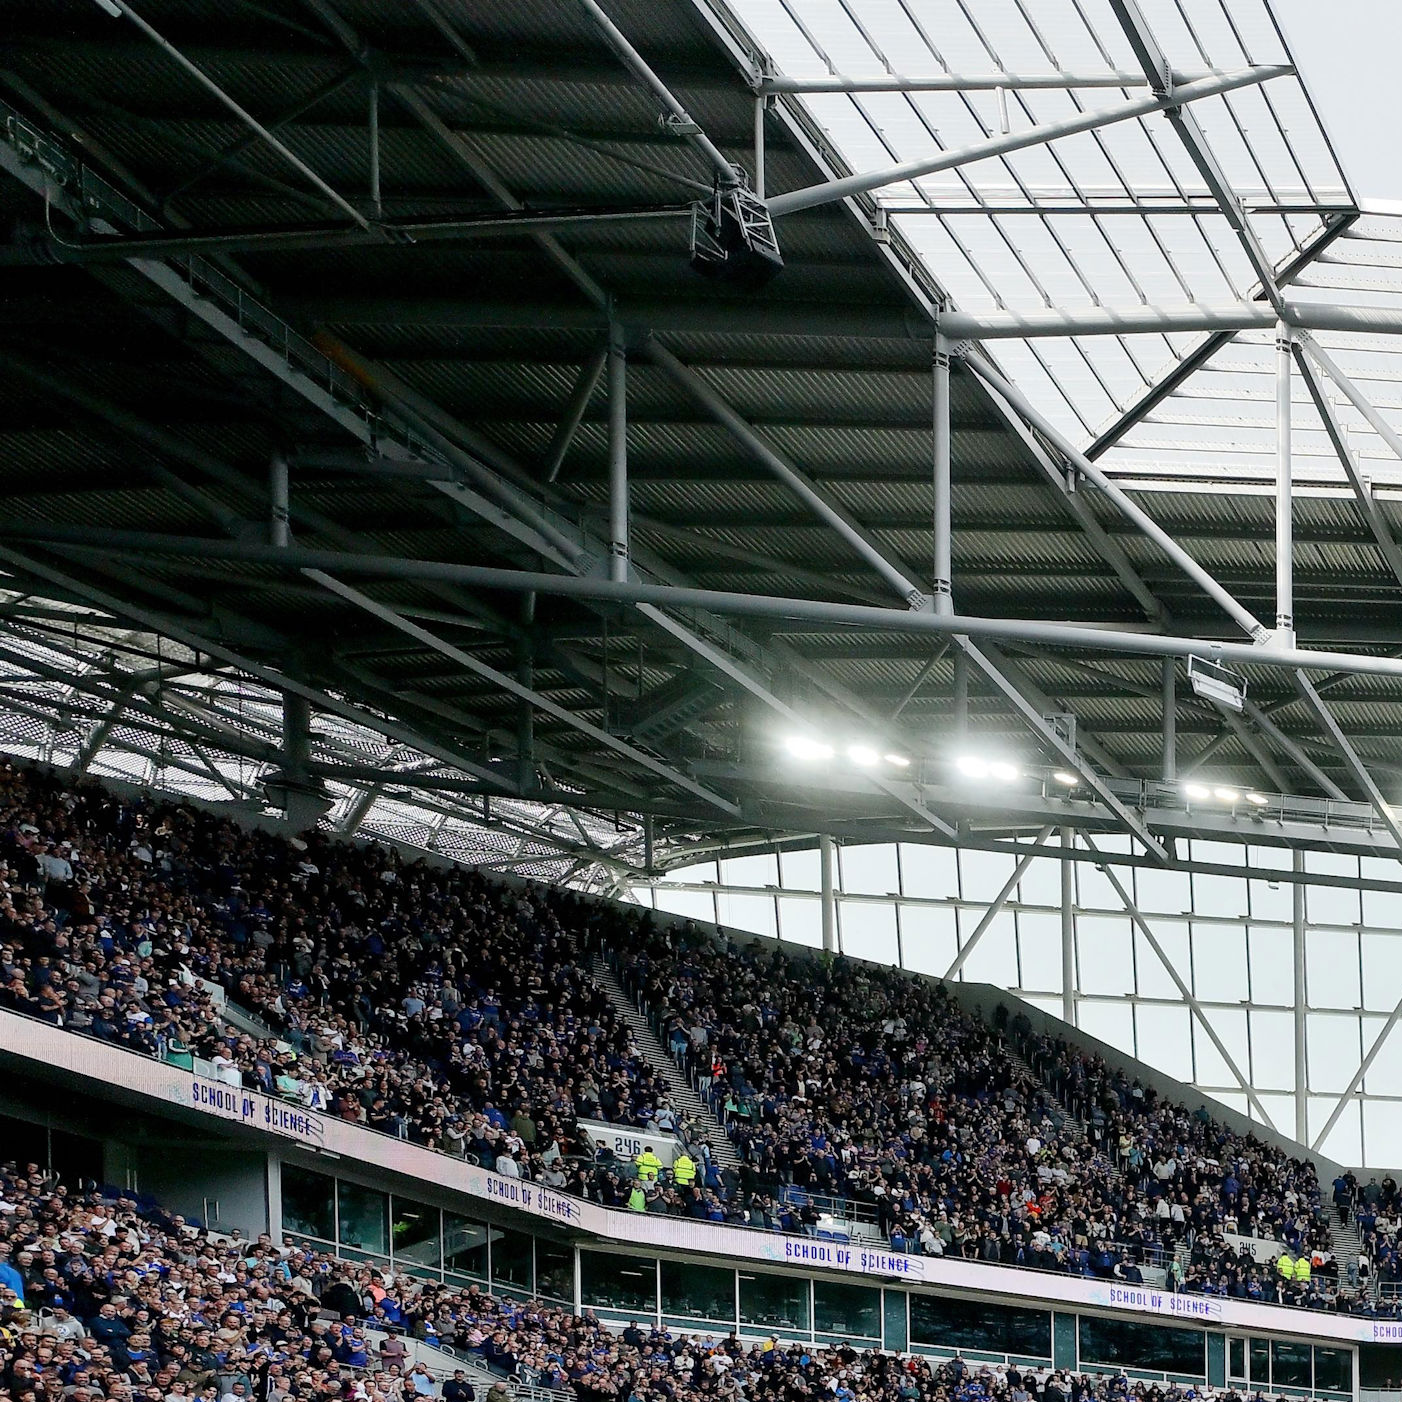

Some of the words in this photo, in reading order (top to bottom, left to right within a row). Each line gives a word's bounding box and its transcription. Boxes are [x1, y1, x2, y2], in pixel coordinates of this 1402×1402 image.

[193, 1081, 238, 1114] SCHOOL
[242, 1097, 255, 1119] OF
[265, 1106, 311, 1136] SCIENCE
[615, 1136, 641, 1155] 246
[487, 1177, 520, 1203] SCHOOL
[522, 1188, 531, 1206] OF
[538, 1192, 571, 1218] SCIENCE
[785, 1241, 832, 1264] SCHOOL
[837, 1247, 851, 1266] OF
[861, 1253, 909, 1274] SCIENCE
[1110, 1289, 1147, 1307] SCHOOL
[1151, 1294, 1162, 1309] OF
[1170, 1297, 1209, 1316] SCIENCE
